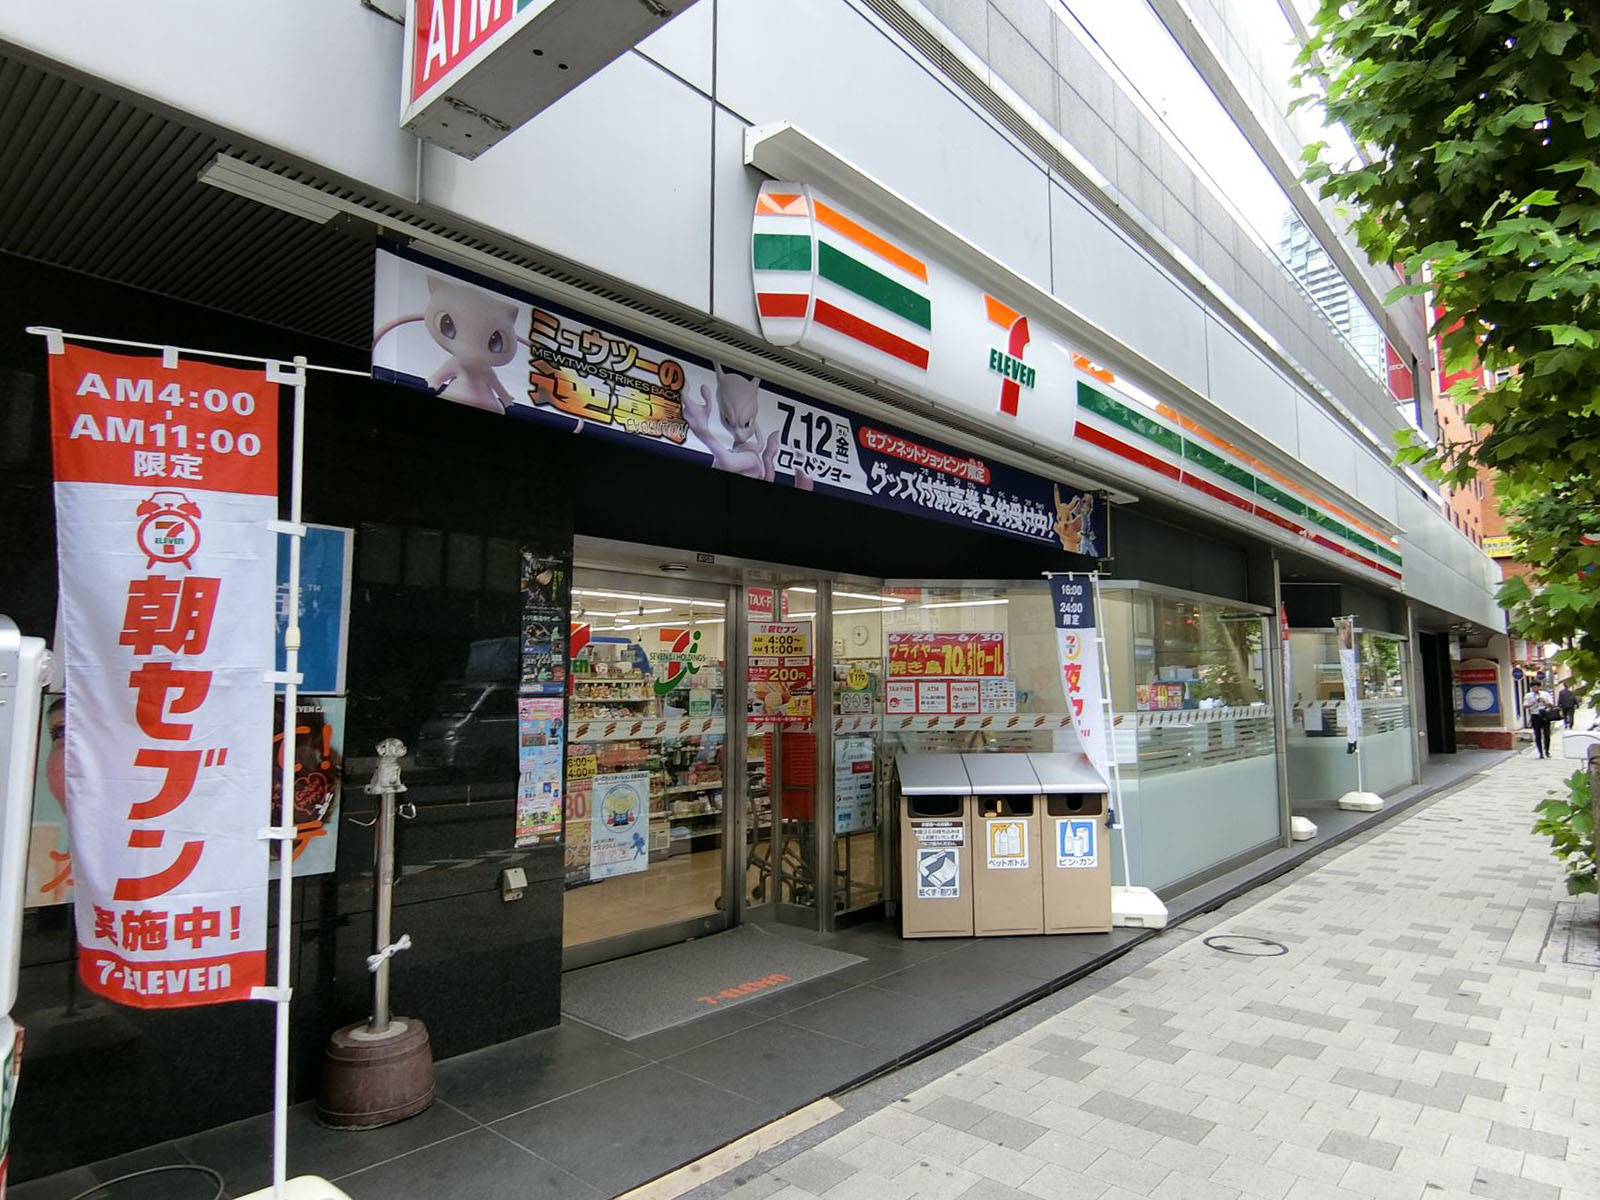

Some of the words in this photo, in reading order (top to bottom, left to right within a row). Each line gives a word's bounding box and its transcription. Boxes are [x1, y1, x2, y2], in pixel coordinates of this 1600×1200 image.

[530, 308, 685, 391] ミュウツーの
[531, 346, 598, 375] MEWTWO
[598, 368, 651, 392] STRIKES
[650, 386, 681, 401] BACK
[777, 401, 832, 459] 7.12
[866, 429, 985, 483] セブンネットショッピング限定
[133, 450, 204, 482] 限定
[778, 449, 852, 482] ロードショー
[988, 859, 1028, 867] ペットボトル
